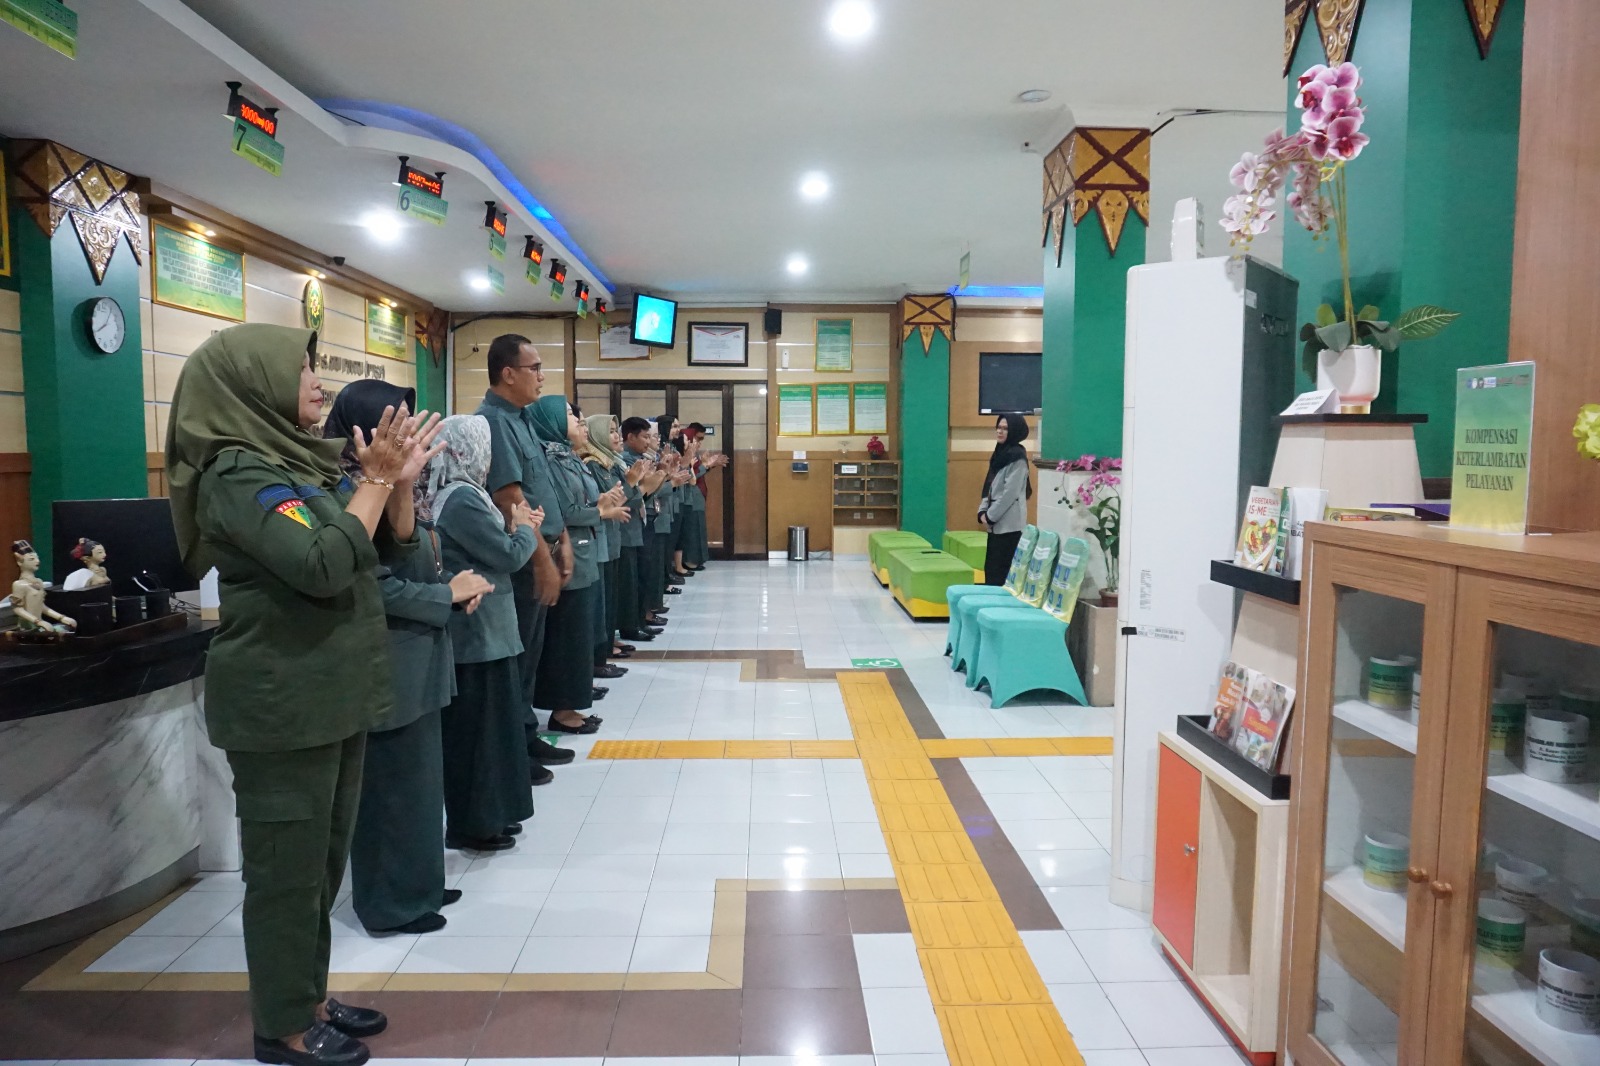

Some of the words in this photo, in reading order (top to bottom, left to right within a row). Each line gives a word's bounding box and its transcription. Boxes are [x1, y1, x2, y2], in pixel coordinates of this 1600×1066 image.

[236, 123, 247, 151] 7
[400, 189, 411, 211] 6
[1465, 428, 1519, 445] KOMPENSASI
[1456, 451, 1528, 469] KETERLAMBATAN
[1465, 473, 1514, 491] PELAYANAN
[1251, 496, 1280, 507] VEGETARIAN
[1248, 505, 1268, 517] IS-ME
